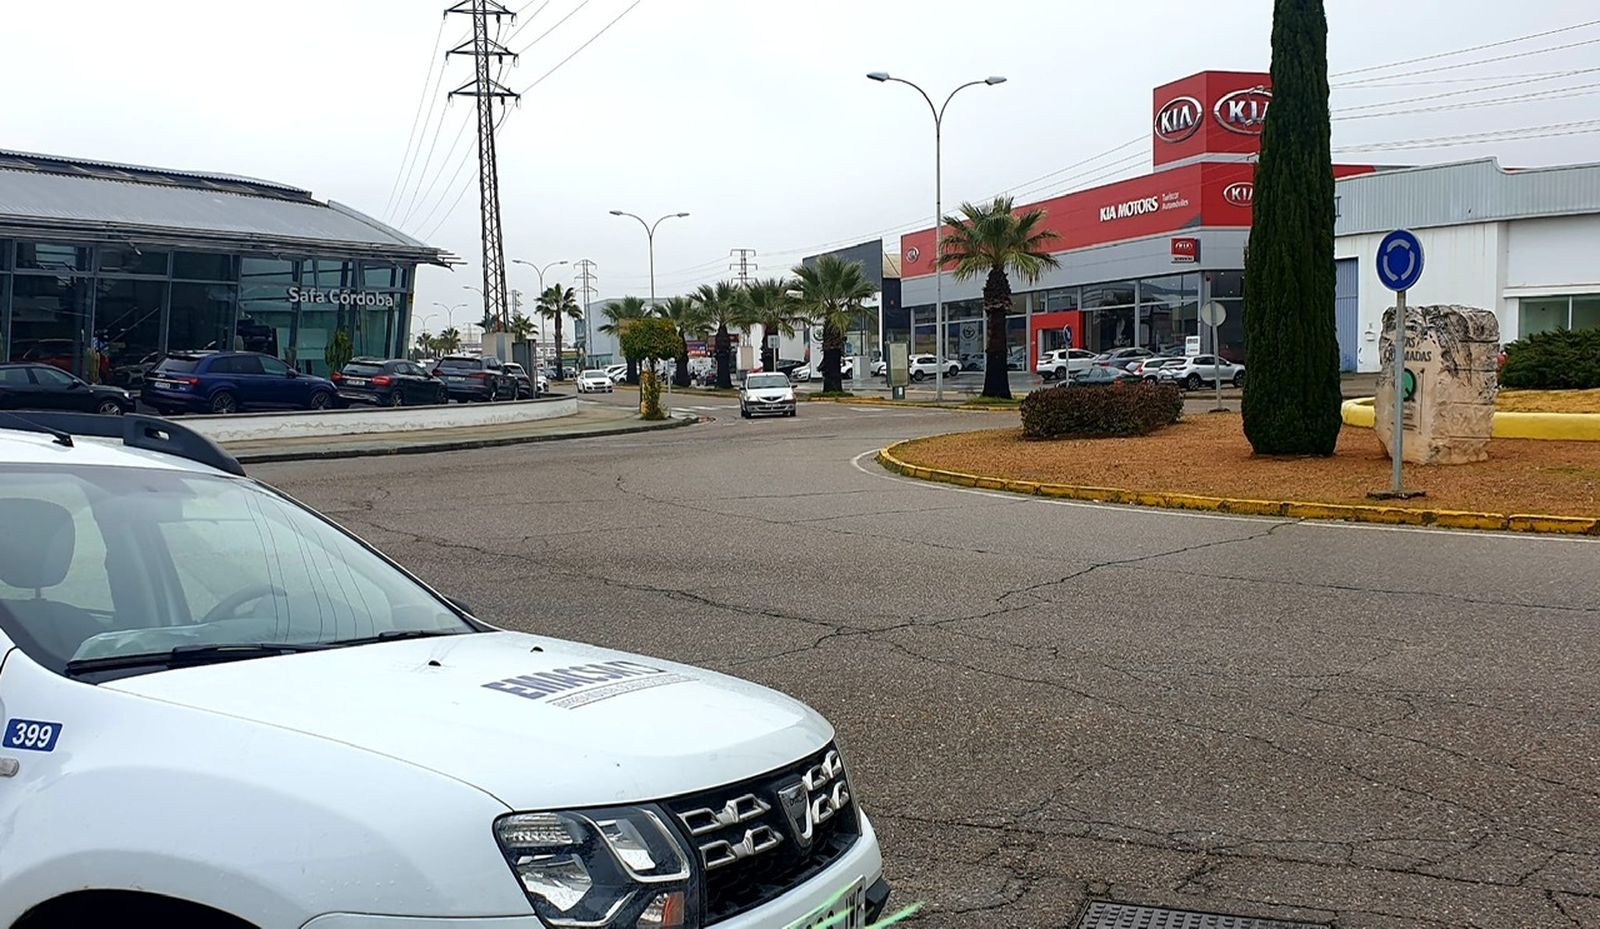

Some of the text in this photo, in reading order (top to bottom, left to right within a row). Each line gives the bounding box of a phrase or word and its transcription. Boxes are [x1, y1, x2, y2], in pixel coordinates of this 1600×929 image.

[1161, 105, 1193, 134] KIA
[1100, 196, 1158, 222] KIA MOTORS
[288, 287, 394, 307] Safa Córdoba
[12, 722, 53, 748] 399
